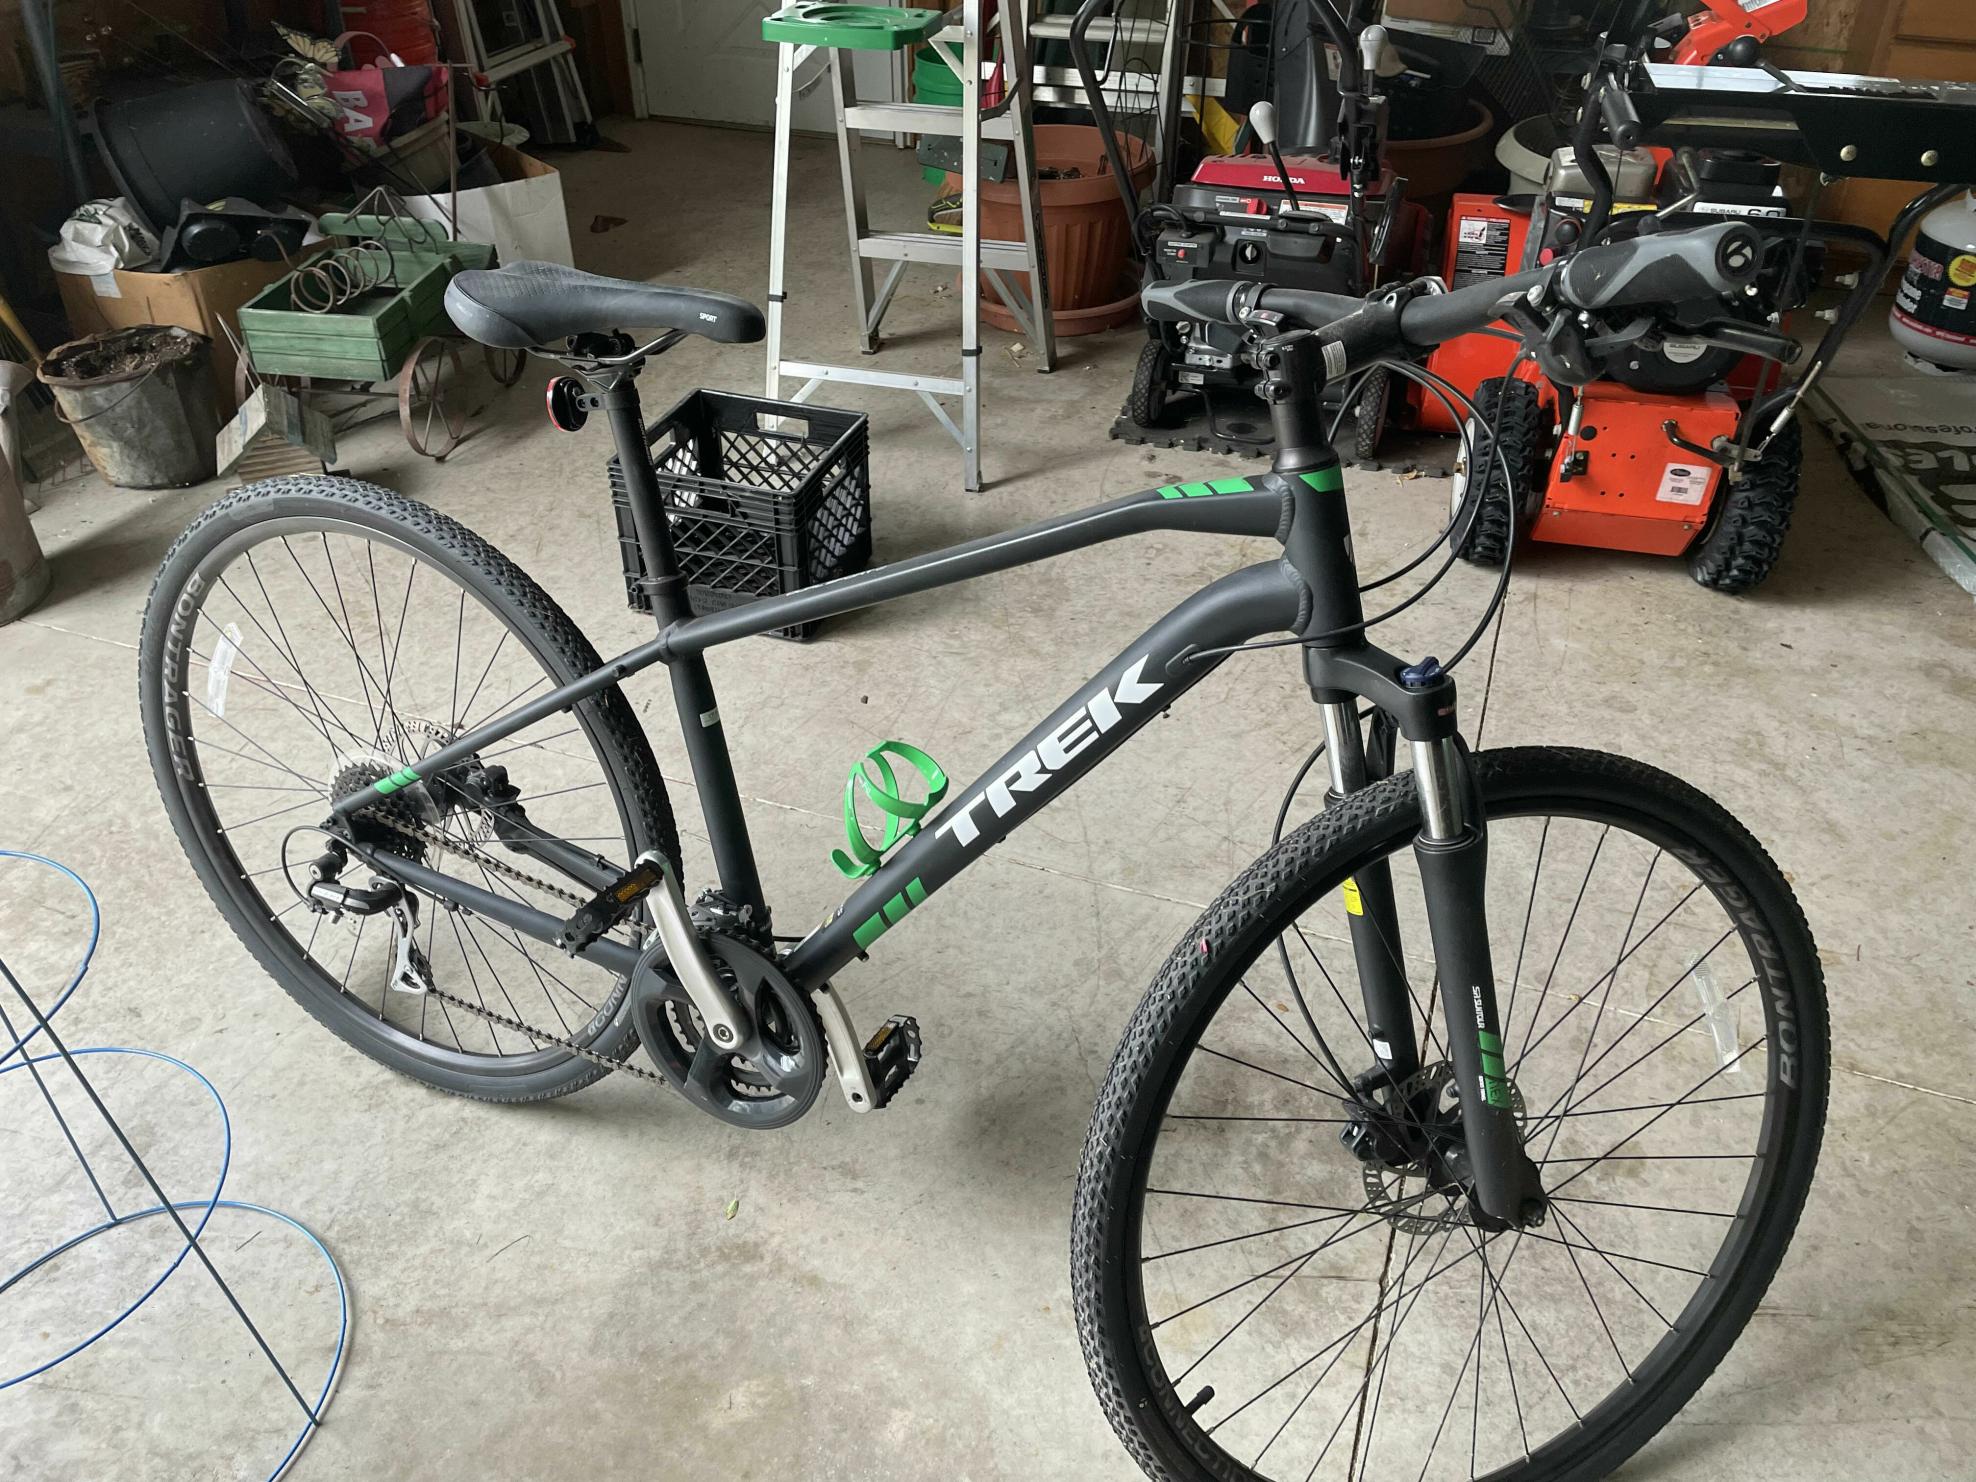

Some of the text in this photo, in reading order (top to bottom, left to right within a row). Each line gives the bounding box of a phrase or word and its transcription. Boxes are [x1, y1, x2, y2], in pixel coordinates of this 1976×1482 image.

[1263, 175, 1305, 184] HODA
[162, 571, 205, 782] BONTRAGER
[934, 653, 1165, 848] TREK
[1674, 846, 1802, 1089] BONTRAGER
